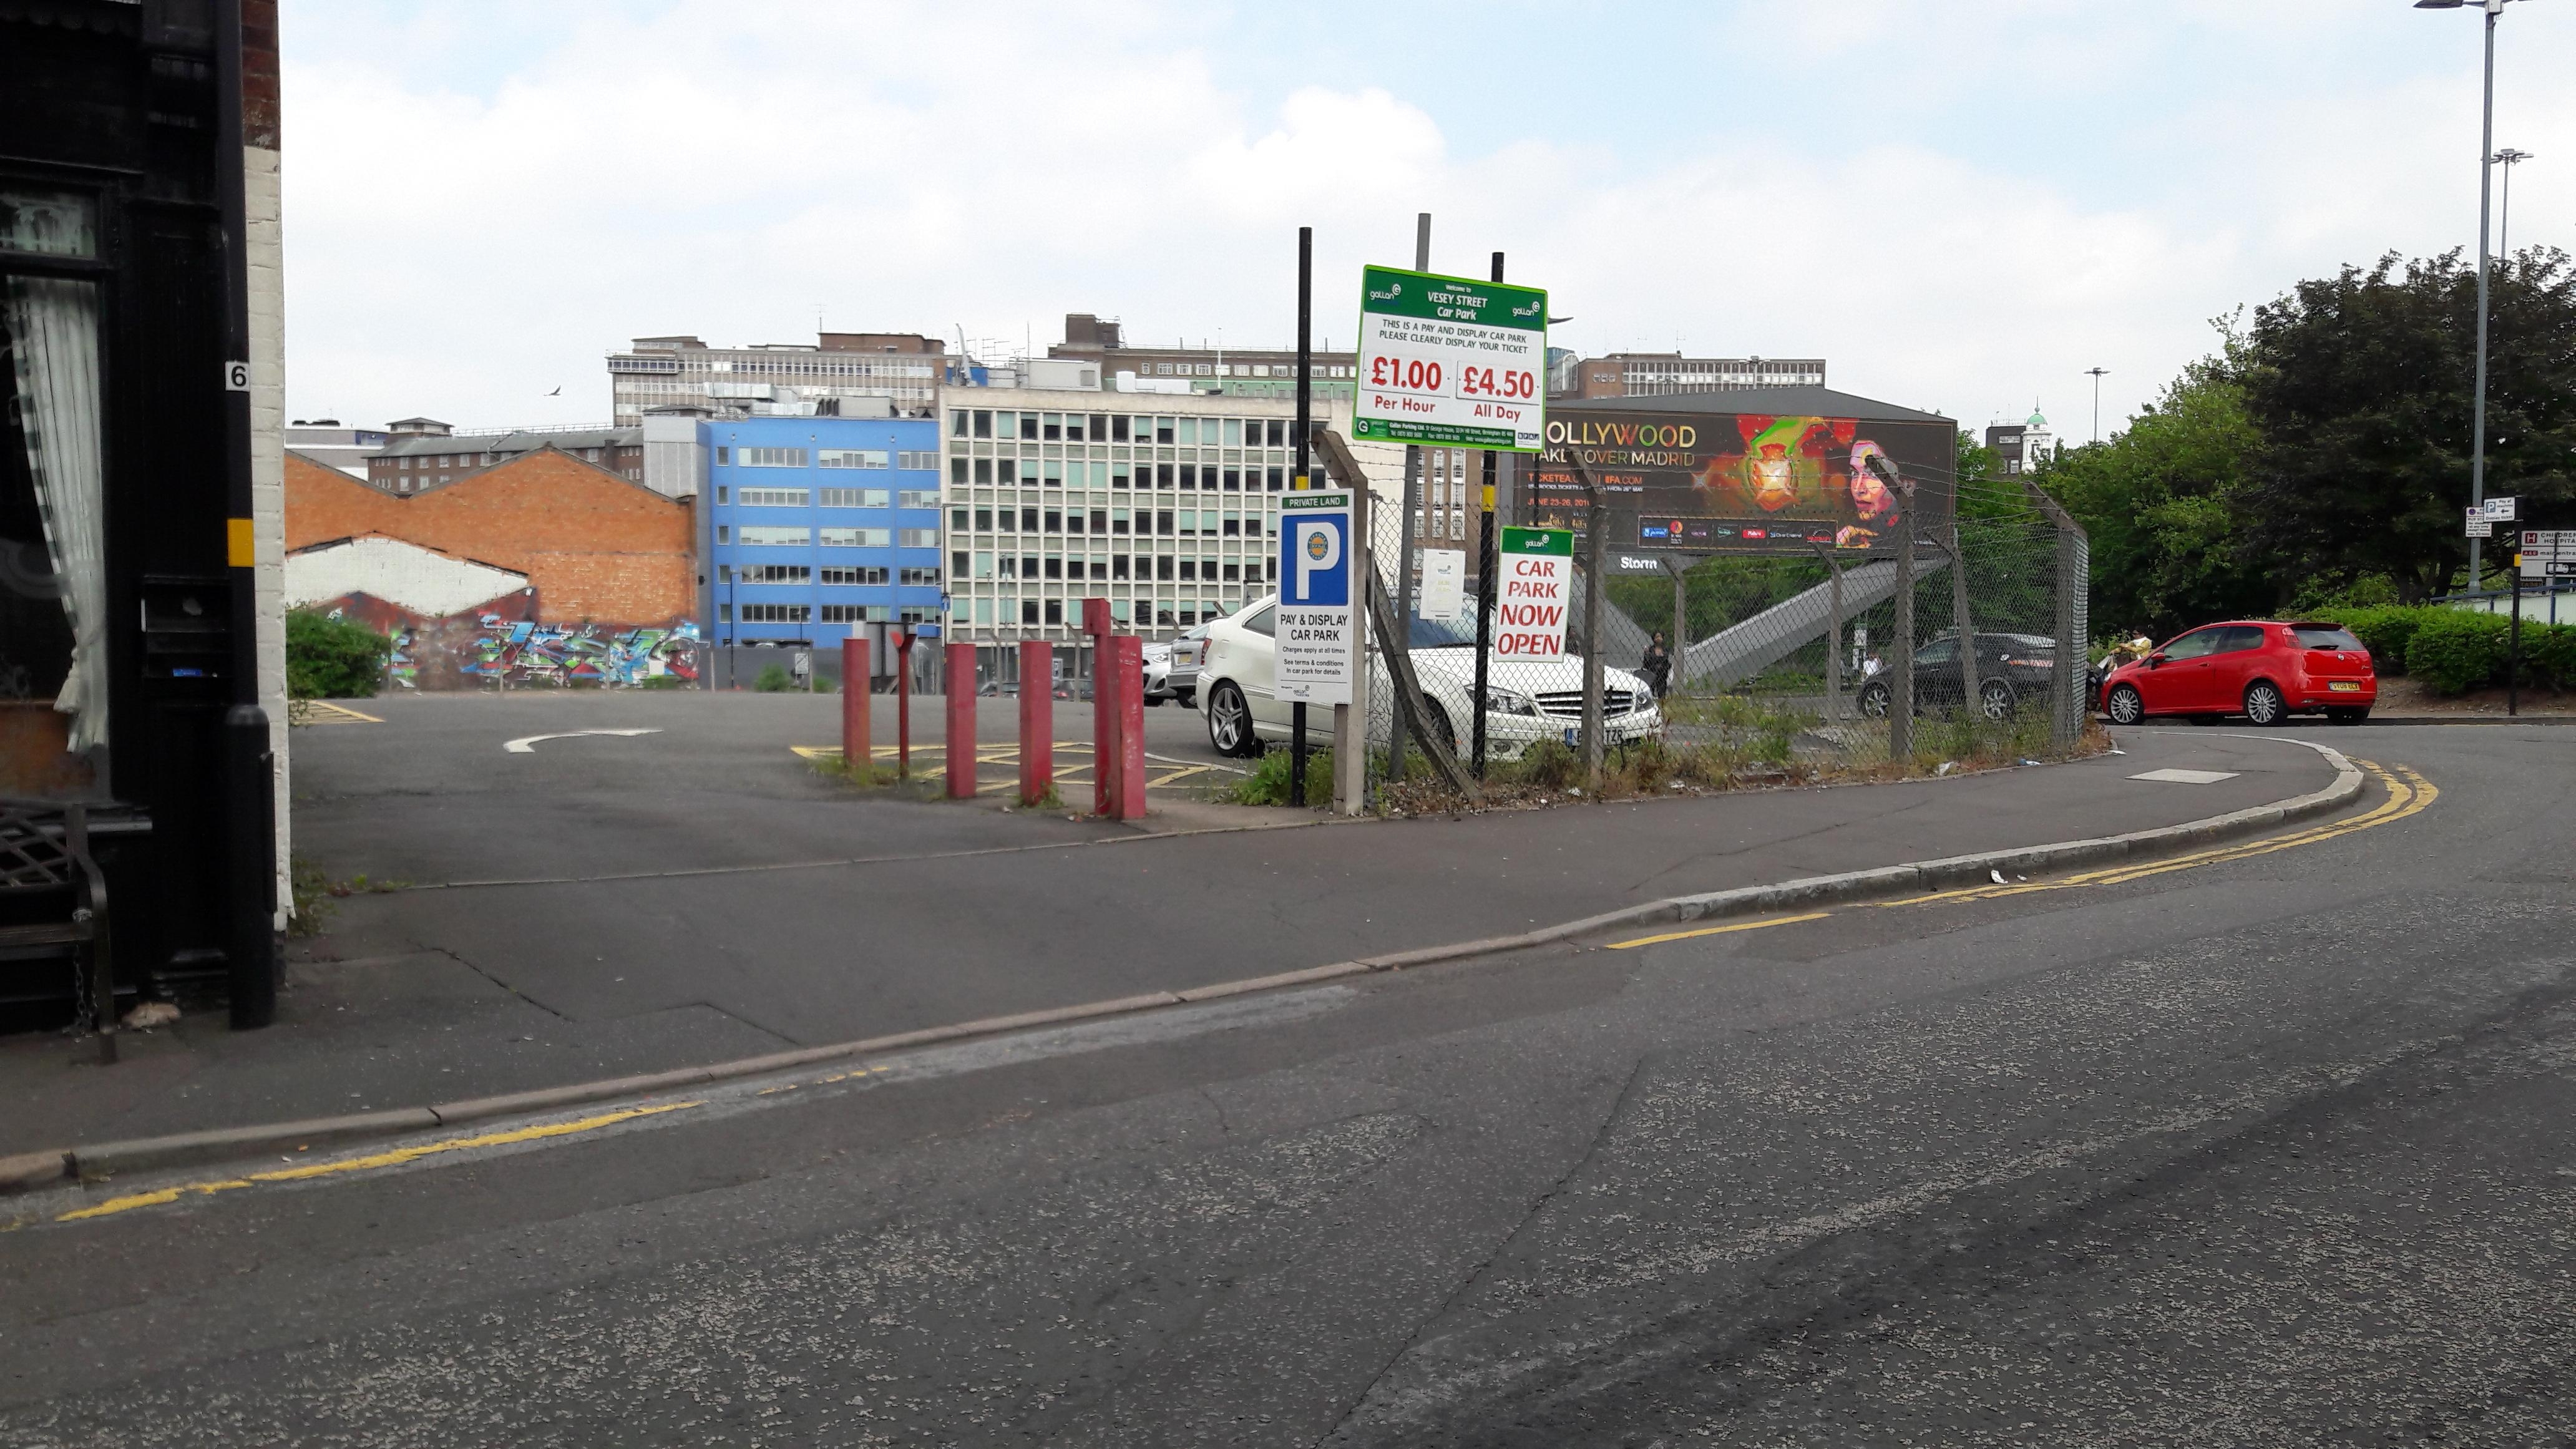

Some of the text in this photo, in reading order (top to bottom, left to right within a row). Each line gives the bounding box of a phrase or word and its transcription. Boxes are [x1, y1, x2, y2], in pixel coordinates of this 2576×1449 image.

[1428, 291, 1488, 308] VESEY STREET
[1437, 306, 1476, 320] Car Park
[1383, 319, 1400, 328] THIS
[1403, 321, 1410, 329] IS
[1422, 324, 1435, 333] PAY
[1438, 326, 1454, 335] AND
[1458, 328, 1488, 338] DISPLAY
[1490, 332, 1505, 341] CAR
[1508, 334, 1526, 343] PARK
[1379, 330, 1528, 354] PLEASE CLEARLY DISPLAY YOUR TICKET
[232, 366, 246, 387] 6
[1371, 356, 1442, 391] £1.00
[1463, 366, 1534, 399] £4.50
[1375, 396, 1435, 412] Per Hour
[1475, 404, 1521, 423] All Day
[1546, 421, 1697, 448] OLLYWOOD
[1584, 449, 1628, 465] OVER
[1631, 451, 1695, 466] MADRID
[1289, 497, 1340, 507] PRIVATE LAND
[1528, 498, 1549, 506] JNE
[1296, 522, 1340, 600] P
[1516, 560, 1555, 577] CAR
[1621, 557, 1657, 569] Storm
[1508, 581, 1559, 598] PARK
[1281, 614, 1348, 626] PAY & DISPLAY
[1500, 604, 1563, 627] NOW
[1291, 629, 1340, 642] CAR PARK
[1498, 633, 1561, 655] OPEN
